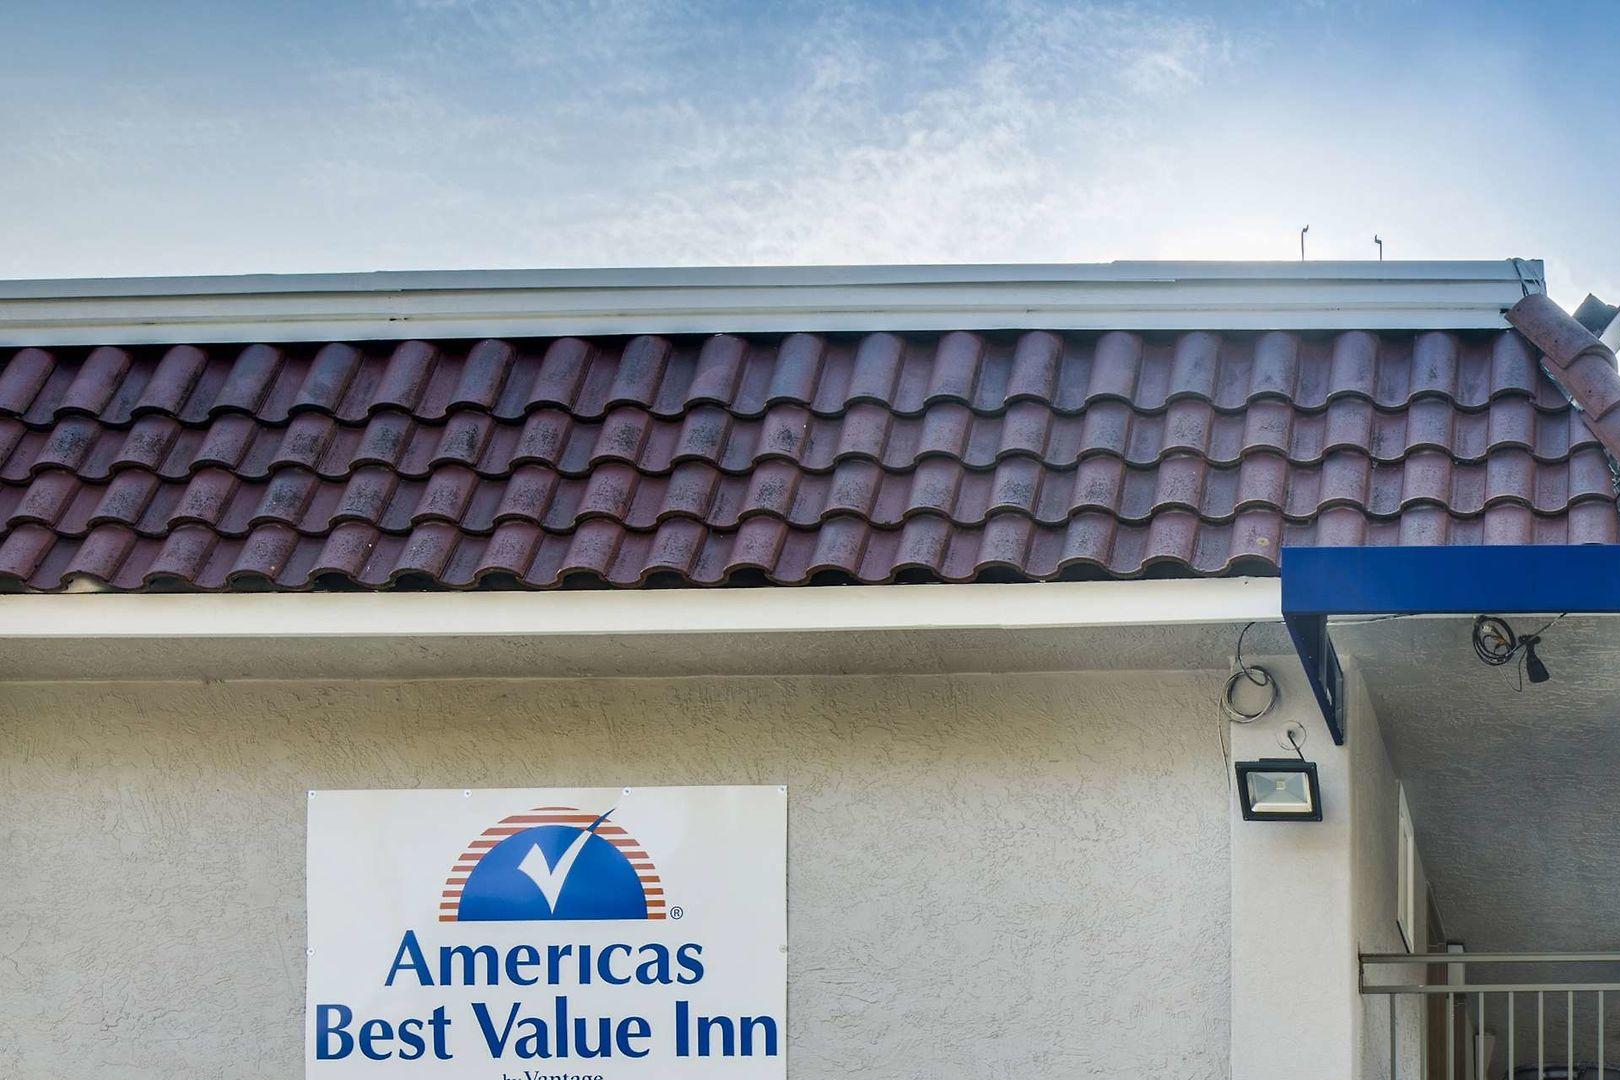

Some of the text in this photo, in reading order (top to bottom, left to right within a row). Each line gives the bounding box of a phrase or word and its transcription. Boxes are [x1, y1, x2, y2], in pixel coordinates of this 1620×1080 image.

[384, 929, 705, 987] Americas
[315, 995, 778, 1061] Best Value Inn
